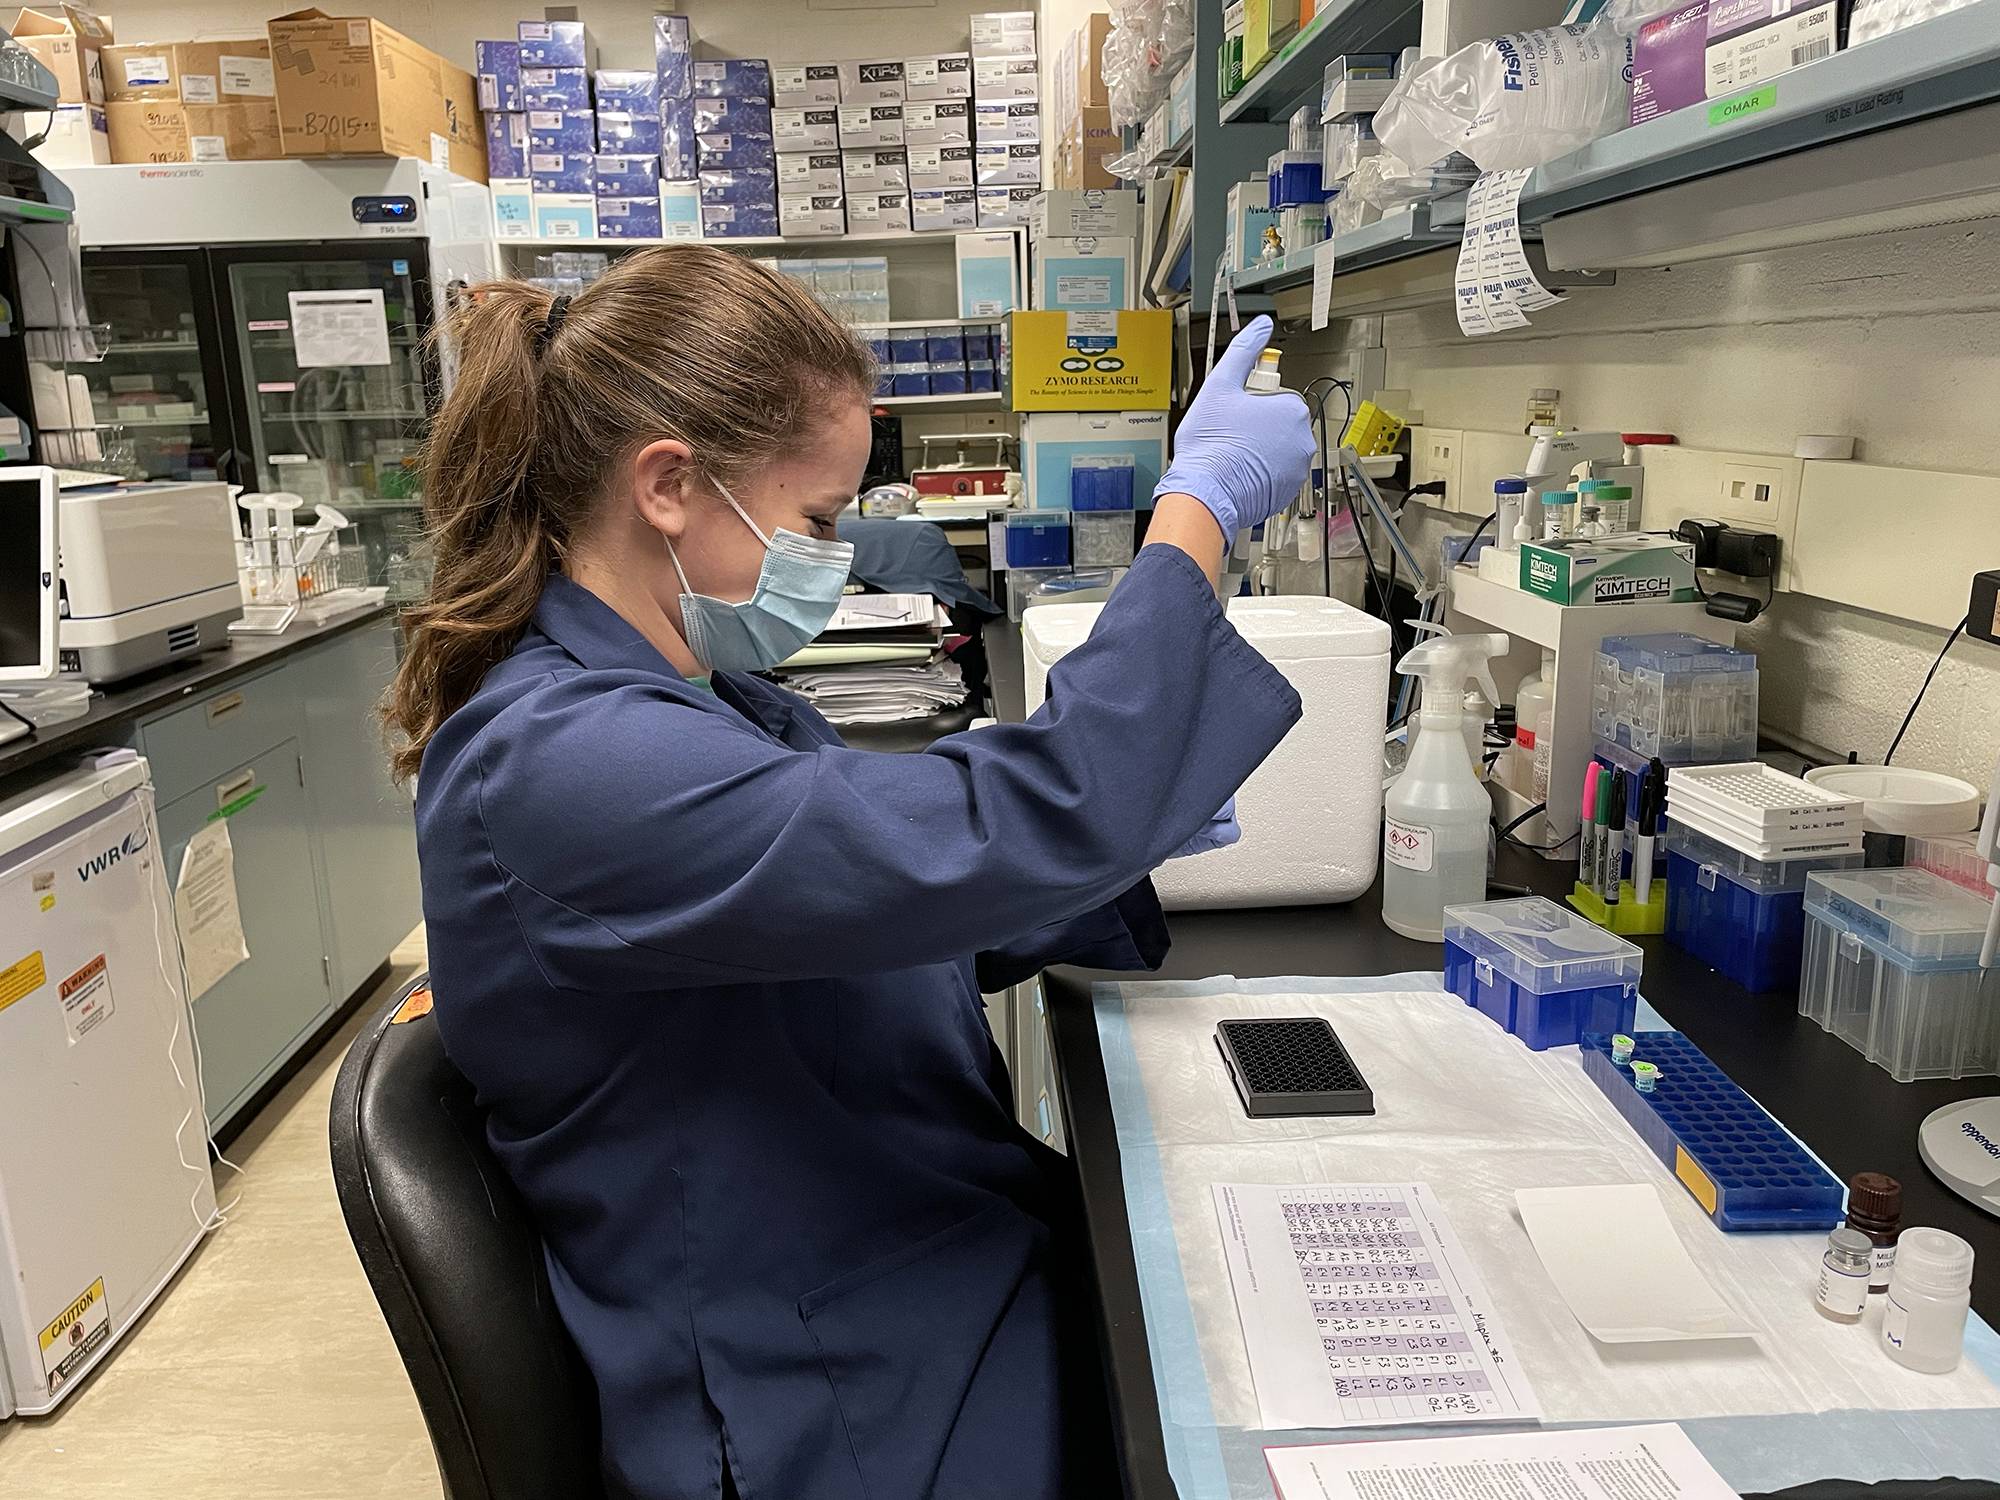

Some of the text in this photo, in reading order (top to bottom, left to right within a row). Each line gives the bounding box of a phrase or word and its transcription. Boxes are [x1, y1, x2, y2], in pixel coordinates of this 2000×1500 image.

[1529, 62, 1540, 86] Petri
[1723, 96, 1760, 117] OMAR
[1045, 375, 1139, 386] ZYMO RESEARCH
[1128, 415, 1163, 426] eppendorf
[1530, 559, 1558, 575] KIMTECH
[1594, 577, 1671, 596] KIMTECH
[77, 846, 122, 884] VWR
[1313, 1251, 1322, 1262] A4
[1328, 1251, 1336, 1261] A4
[1317, 1268, 1329, 1277] E4
[1332, 1266, 1342, 1277] E4
[1323, 1284, 1331, 1295] I2
[1339, 1284, 1348, 1296] I2
[1314, 1302, 1324, 1312] L2
[1328, 1302, 1338, 1312] K4
[1342, 1302, 1353, 1312] K4
[1391, 1266, 1402, 1278] C2
[1397, 1283, 1408, 1294] G4
[1420, 1336, 1432, 1348] C3
[51, 1290, 94, 1339] CAUTION
[1354, 1251, 1416, 1390] A2 C4 H2 J4 A1 D1 F3 K3
[1333, 1319, 1344, 1332] A3
[1340, 1252, 1398, 1391] A2 C4 H2 J4 A1 D1 F3 K3
[1346, 1318, 1358, 1330] A3
[1414, 1282, 1426, 1292] F4
[1420, 1299, 1431, 1311] I4
[1429, 1320, 1440, 1329] L2
[1435, 1338, 1448, 1348] B1
[1445, 1355, 1458, 1366] E3
[1324, 1339, 1336, 1350] E3
[1355, 1338, 1366, 1346] E1
[1376, 1266, 1386, 1278] C2
[1388, 1300, 1400, 1312] J2
[1406, 1338, 1418, 1349] C3
[1428, 1397, 1442, 1412] G2
[1328, 1356, 1341, 1369] J3
